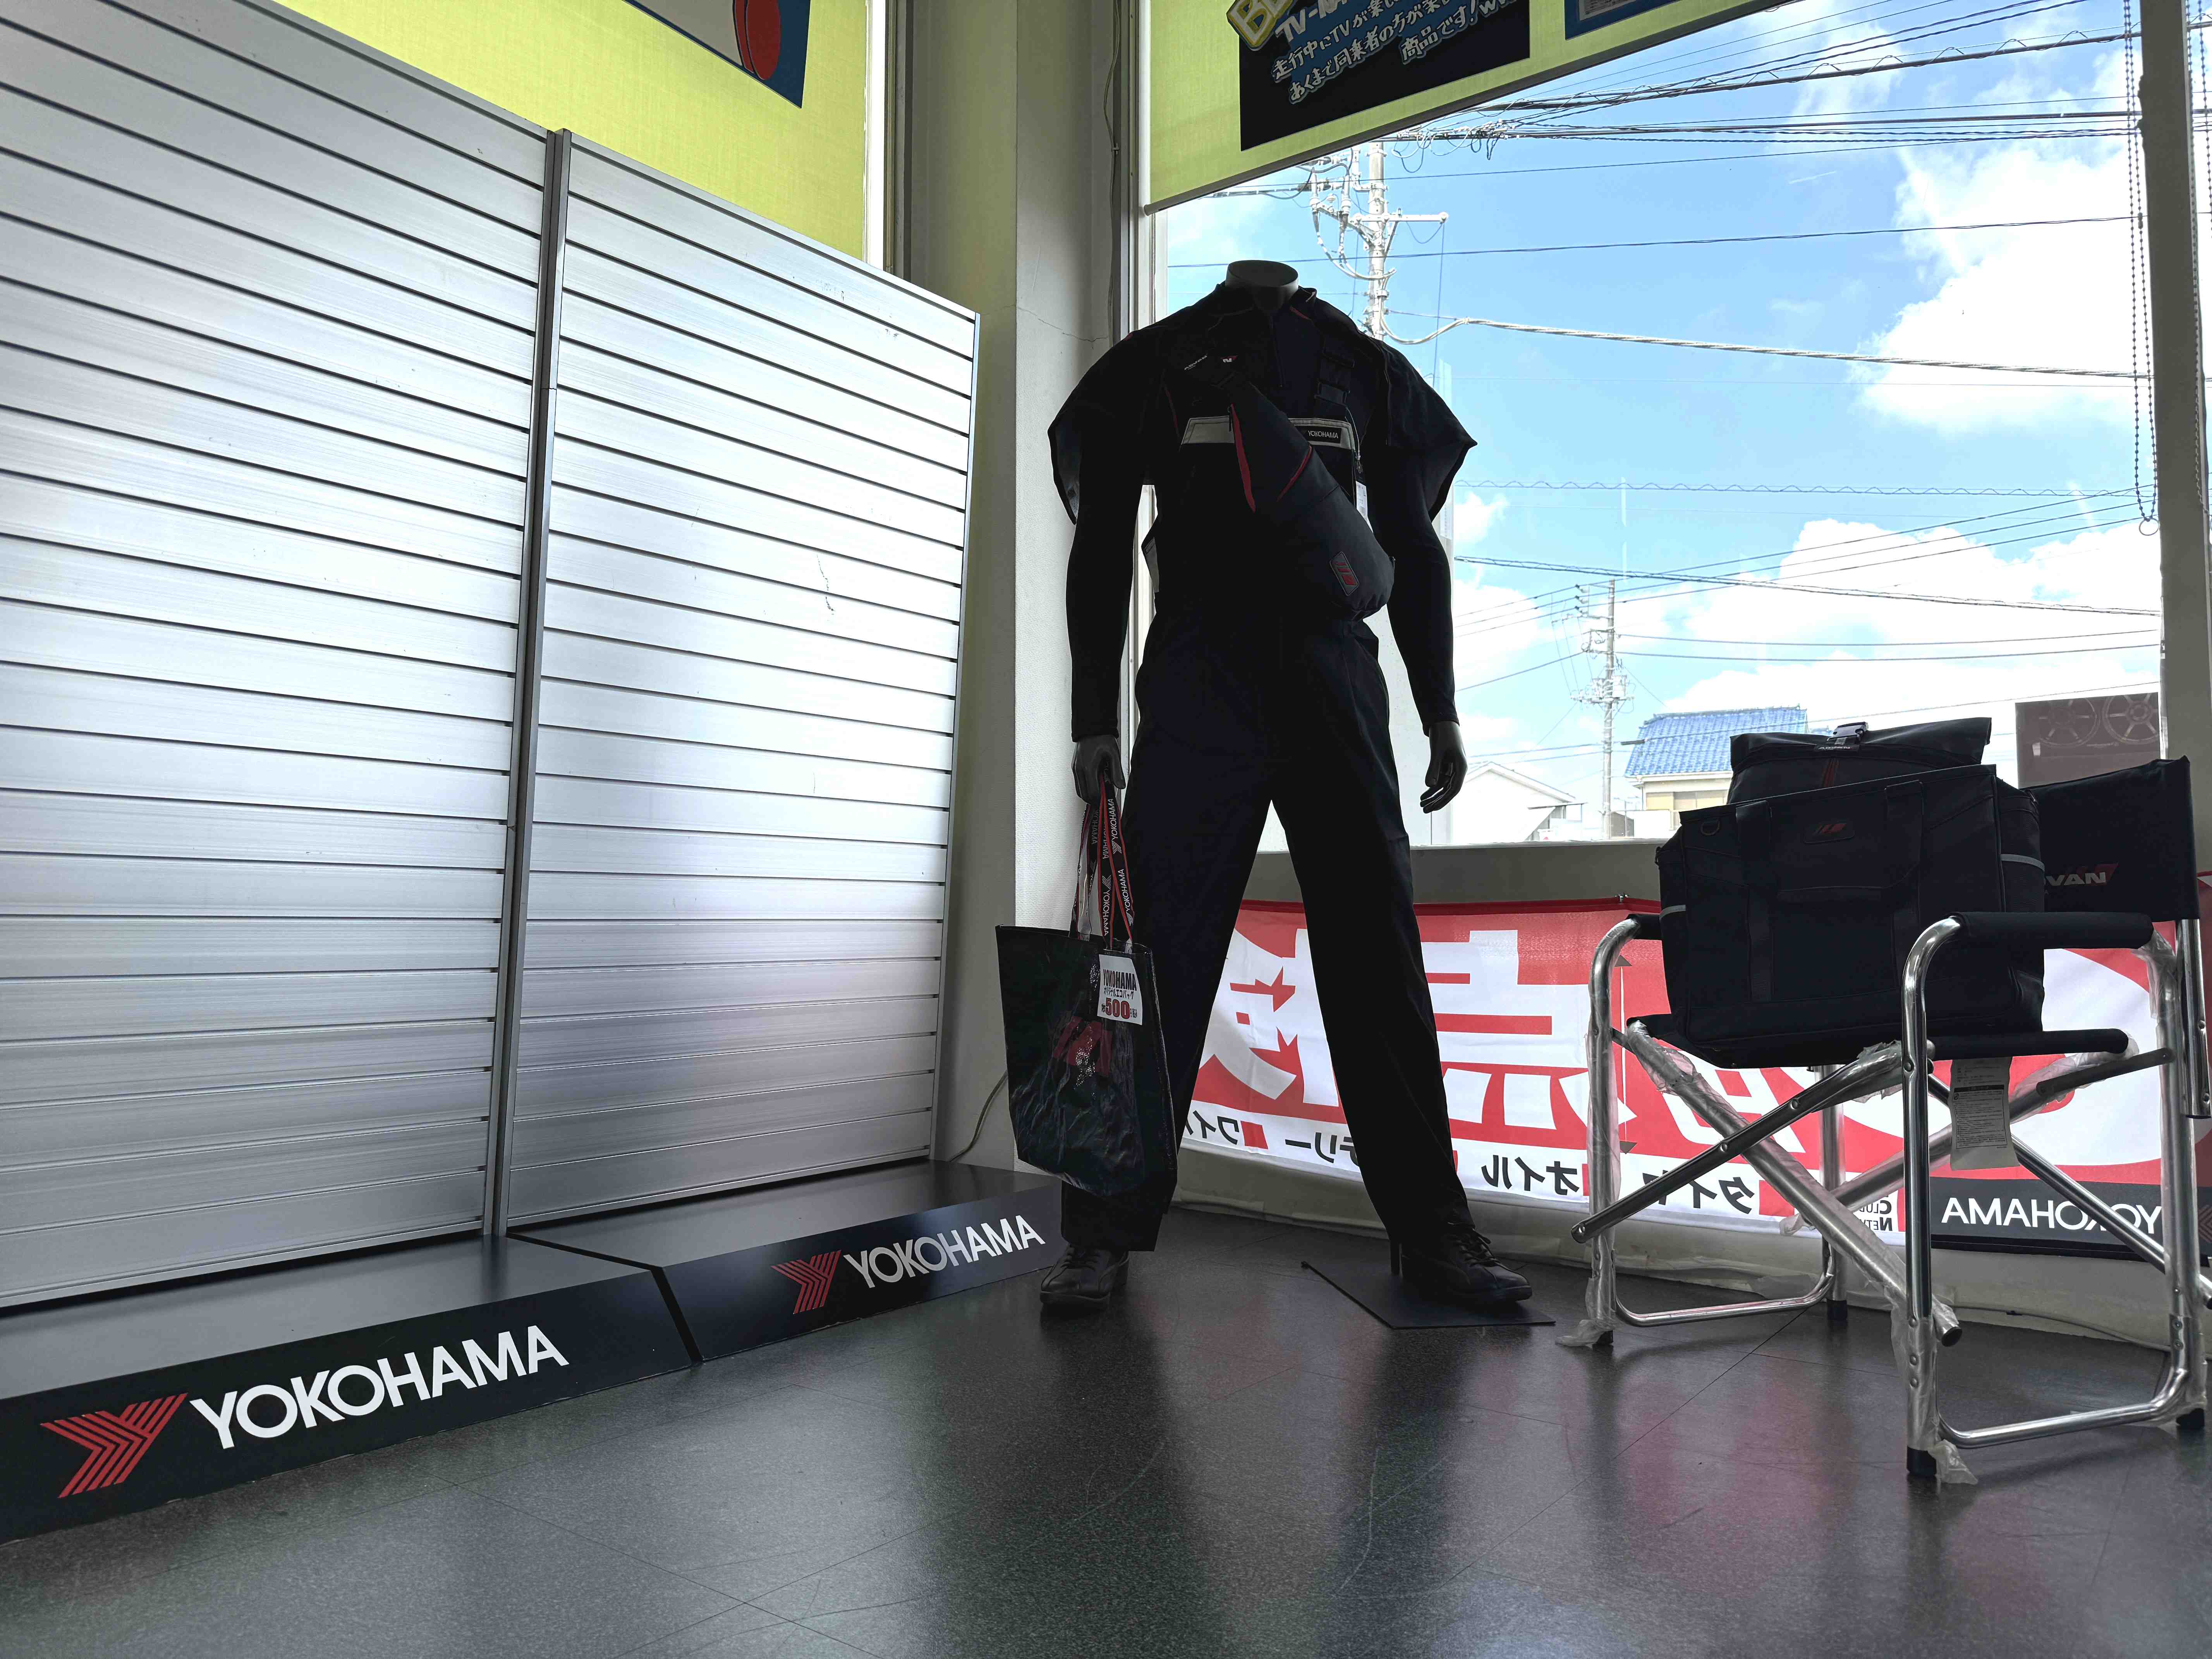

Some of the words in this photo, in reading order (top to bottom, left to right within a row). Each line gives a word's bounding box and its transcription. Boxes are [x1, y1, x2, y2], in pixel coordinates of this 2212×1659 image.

[1273, 0, 1399, 80] 走行中にTVが楽し
[1307, 430, 1339, 439] YOKOHAMA
[1108, 799, 1119, 840] YOKOHAMA
[1118, 869, 1131, 912] YOKOHAMA
[1103, 890, 1111, 936] YOKOHAMA
[1103, 969, 1137, 991] YOKOHAMA
[843, 1215, 1046, 1288] YOKOHAMA
[190, 1325, 569, 1449] YOKOHAMA
